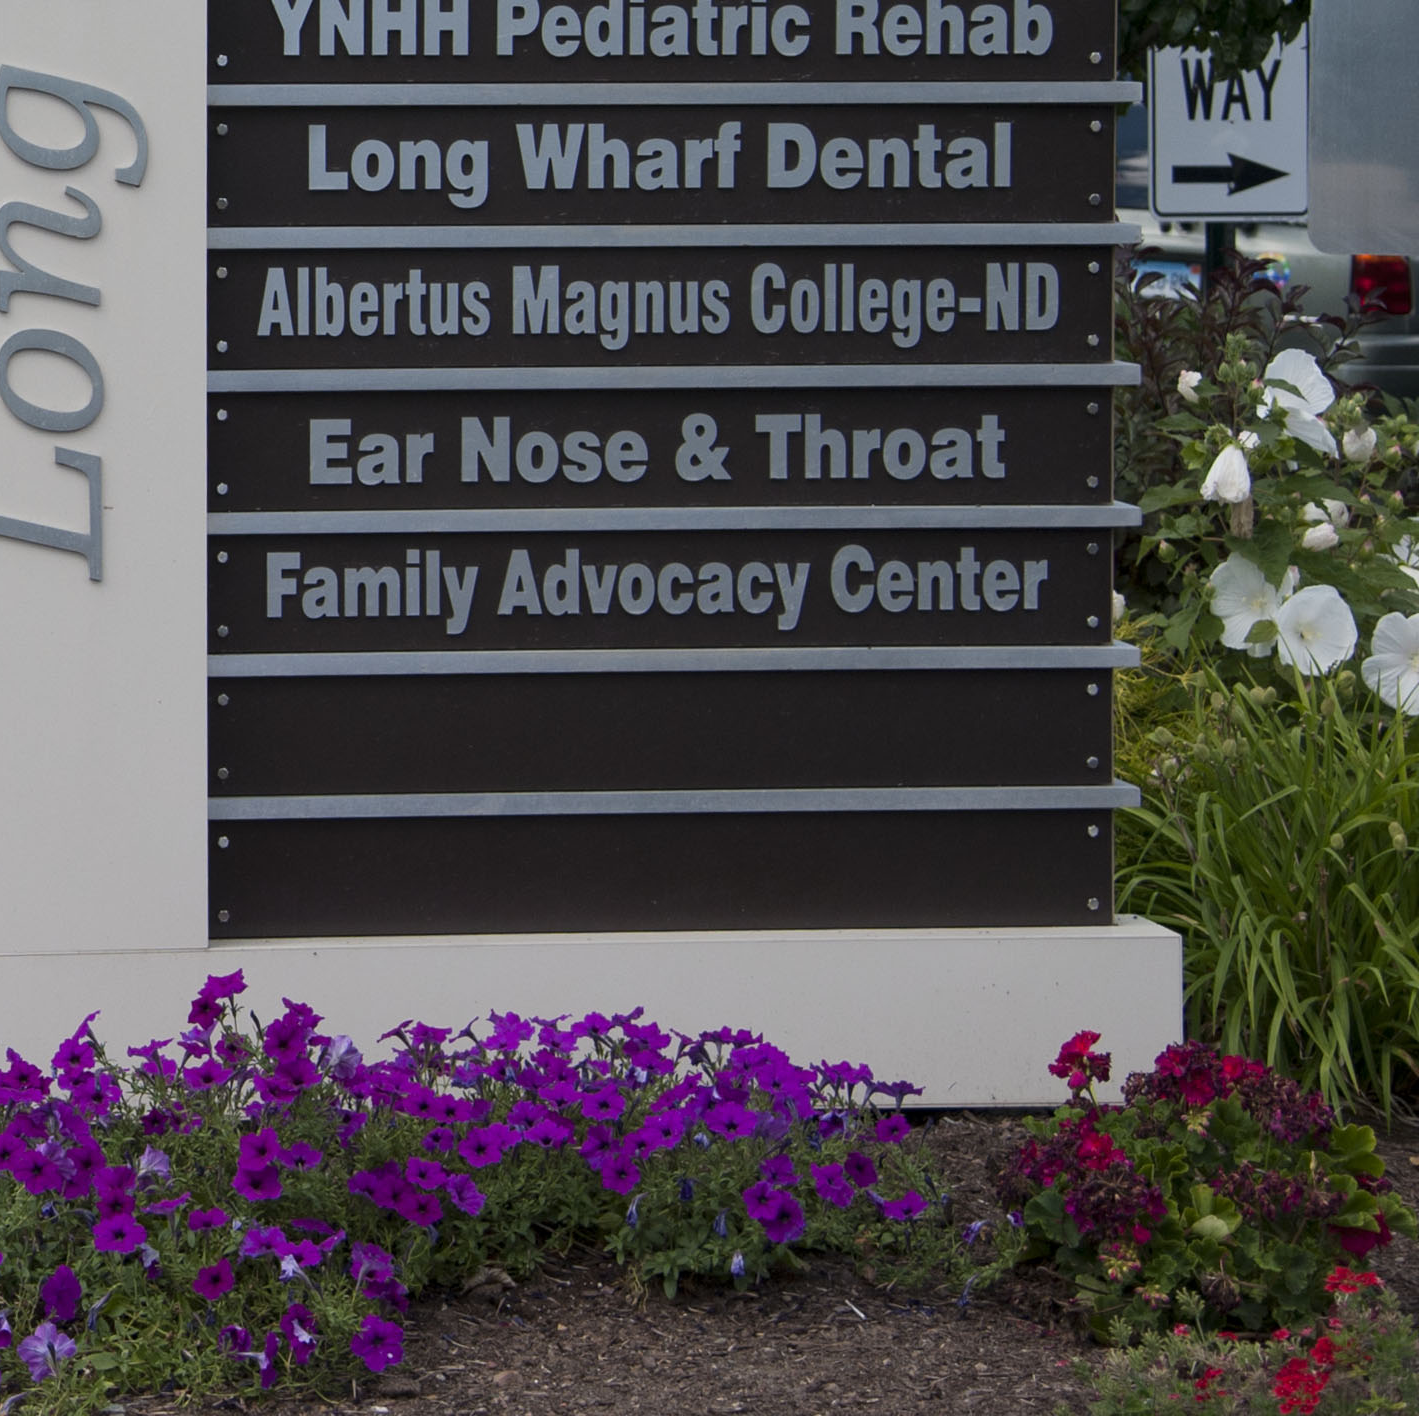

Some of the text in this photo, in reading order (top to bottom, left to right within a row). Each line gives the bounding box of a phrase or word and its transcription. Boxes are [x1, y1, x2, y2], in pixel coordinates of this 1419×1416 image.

[1180, 58, 1281, 121] WAY
[308, 121, 1012, 209] Long Wharf Dental
[257, 262, 1059, 350] Albertus Magnus College-ND
[309, 413, 1006, 486] Ear Nose & Throat
[266, 544, 1048, 635] Family Advocacy Center
